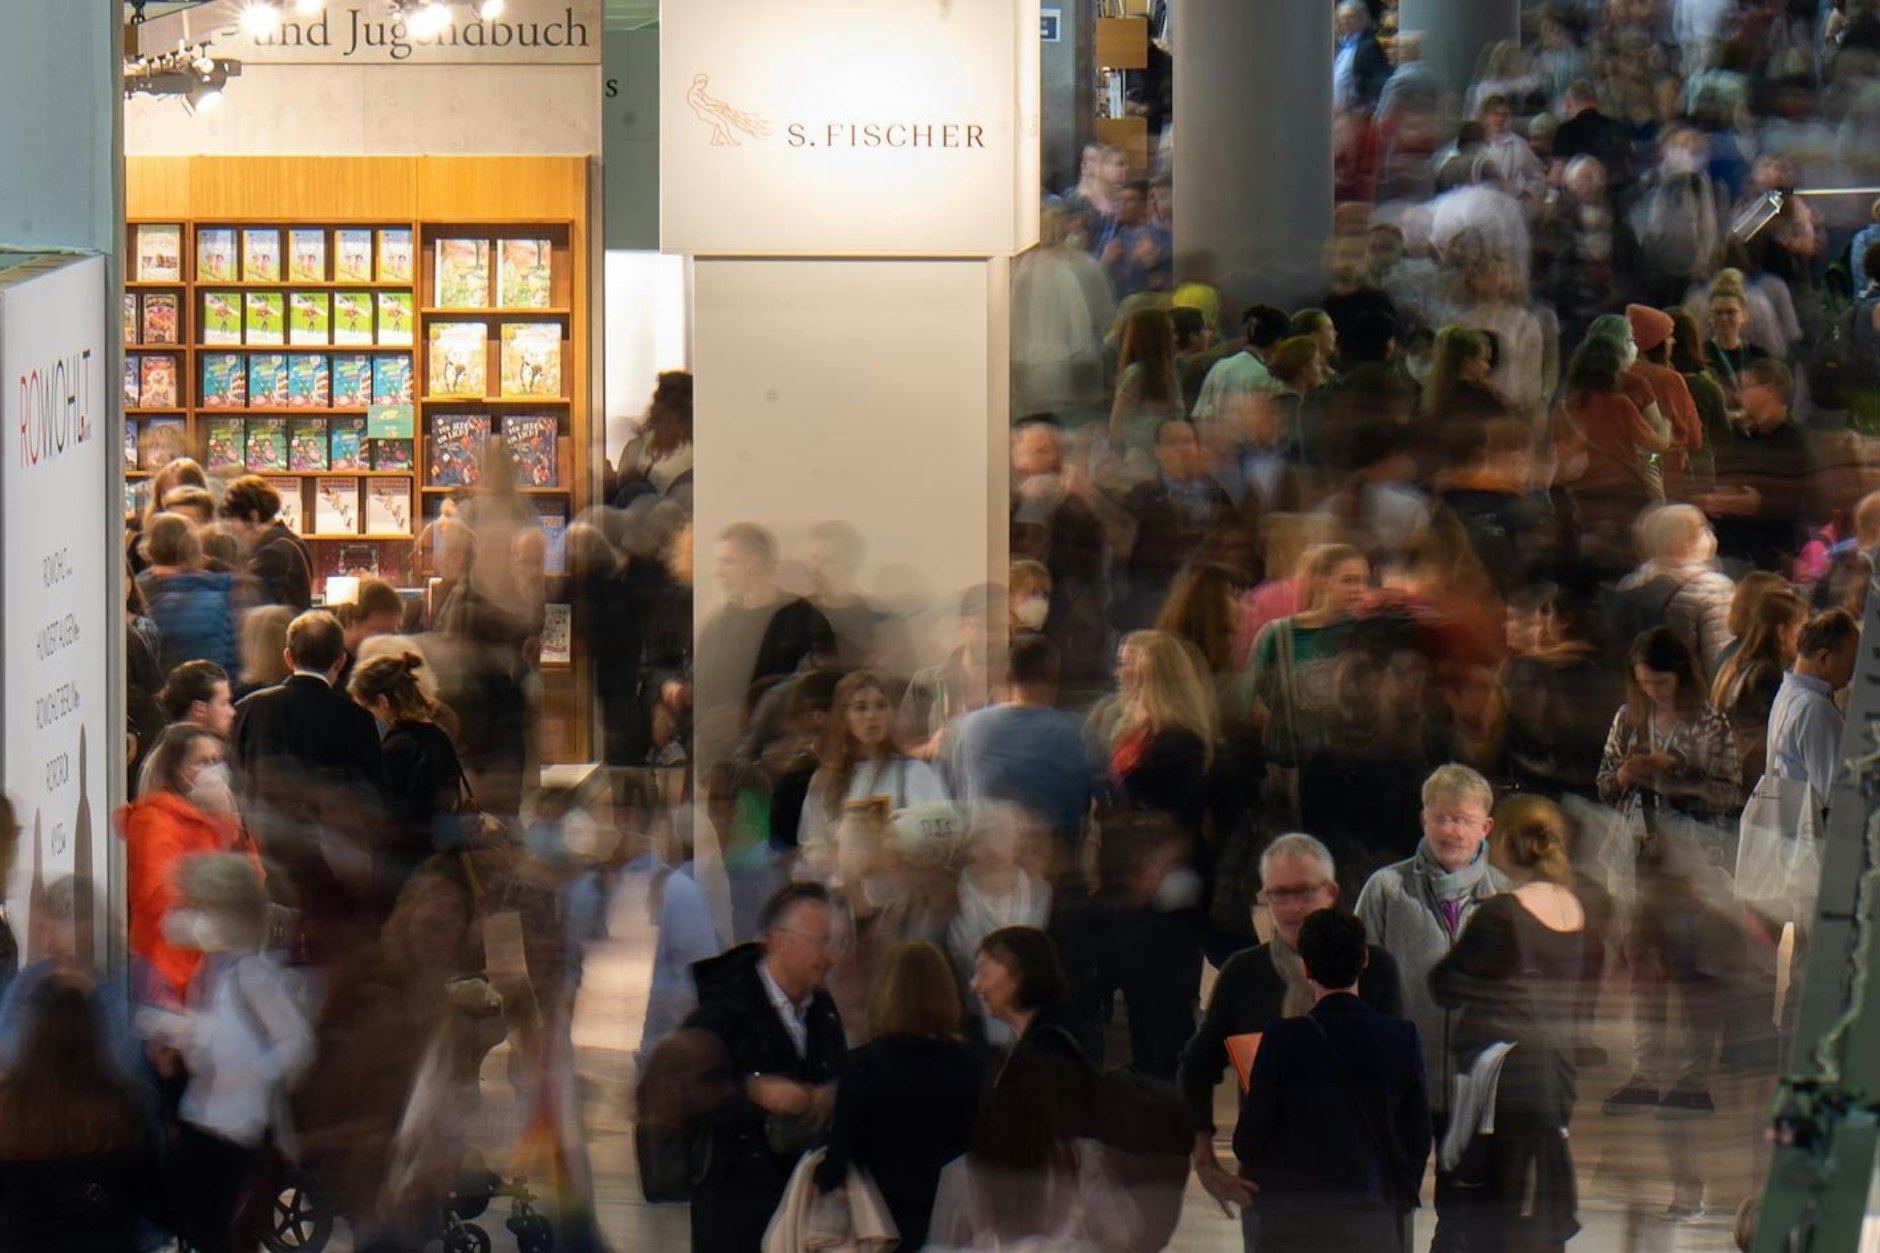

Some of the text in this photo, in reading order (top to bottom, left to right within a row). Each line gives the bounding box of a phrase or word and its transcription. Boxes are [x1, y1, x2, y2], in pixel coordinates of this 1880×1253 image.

[343, 6, 590, 59] Jugndbuch
[787, 123, 986, 149] S. FISCHER
